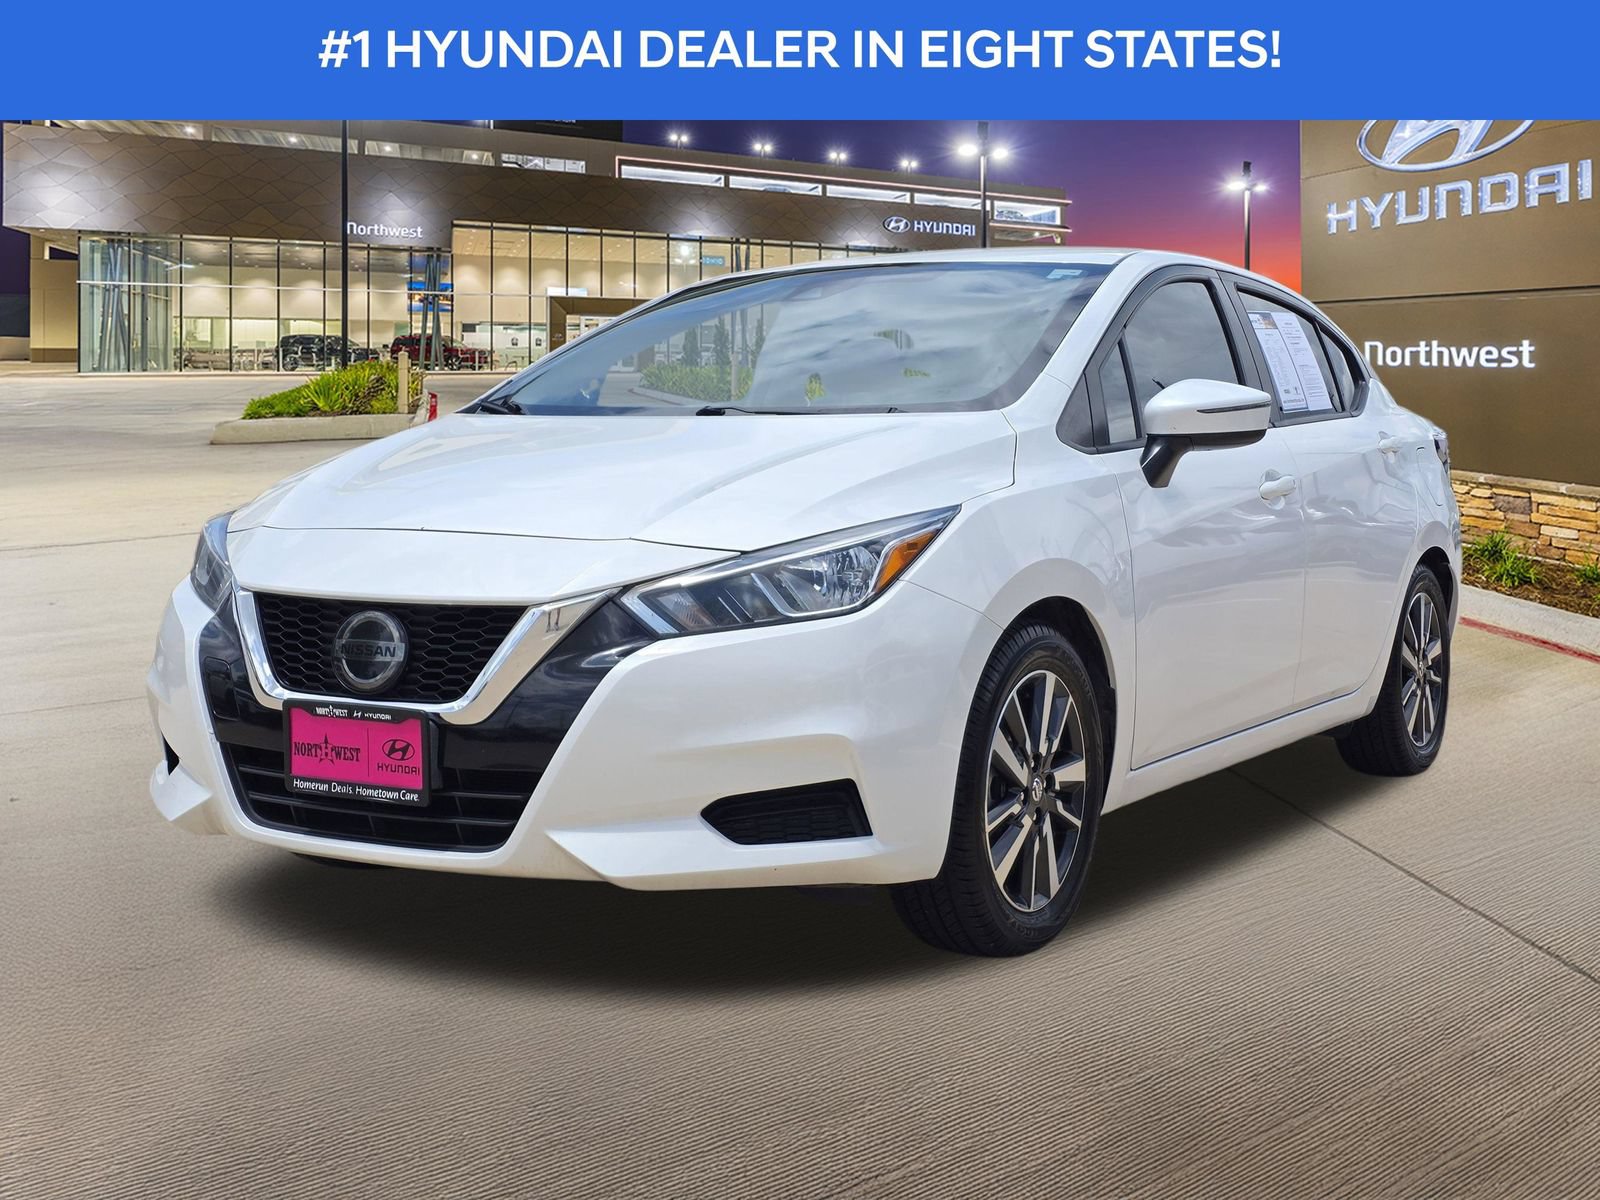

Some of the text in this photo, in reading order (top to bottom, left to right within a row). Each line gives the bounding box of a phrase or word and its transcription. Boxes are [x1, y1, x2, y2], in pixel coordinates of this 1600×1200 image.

[1326, 158, 1593, 235] HYUNDAI
[347, 221, 423, 238] Northwest
[913, 220, 976, 236] HYUNDAI
[1364, 339, 1536, 368] Northwest
[341, 643, 397, 658] NISSAN
[364, 712, 392, 721] HYUNDAI
[376, 762, 421, 776] HYUNDAI
[293, 778, 329, 792] Homerun
[355, 785, 400, 800] Hometown
